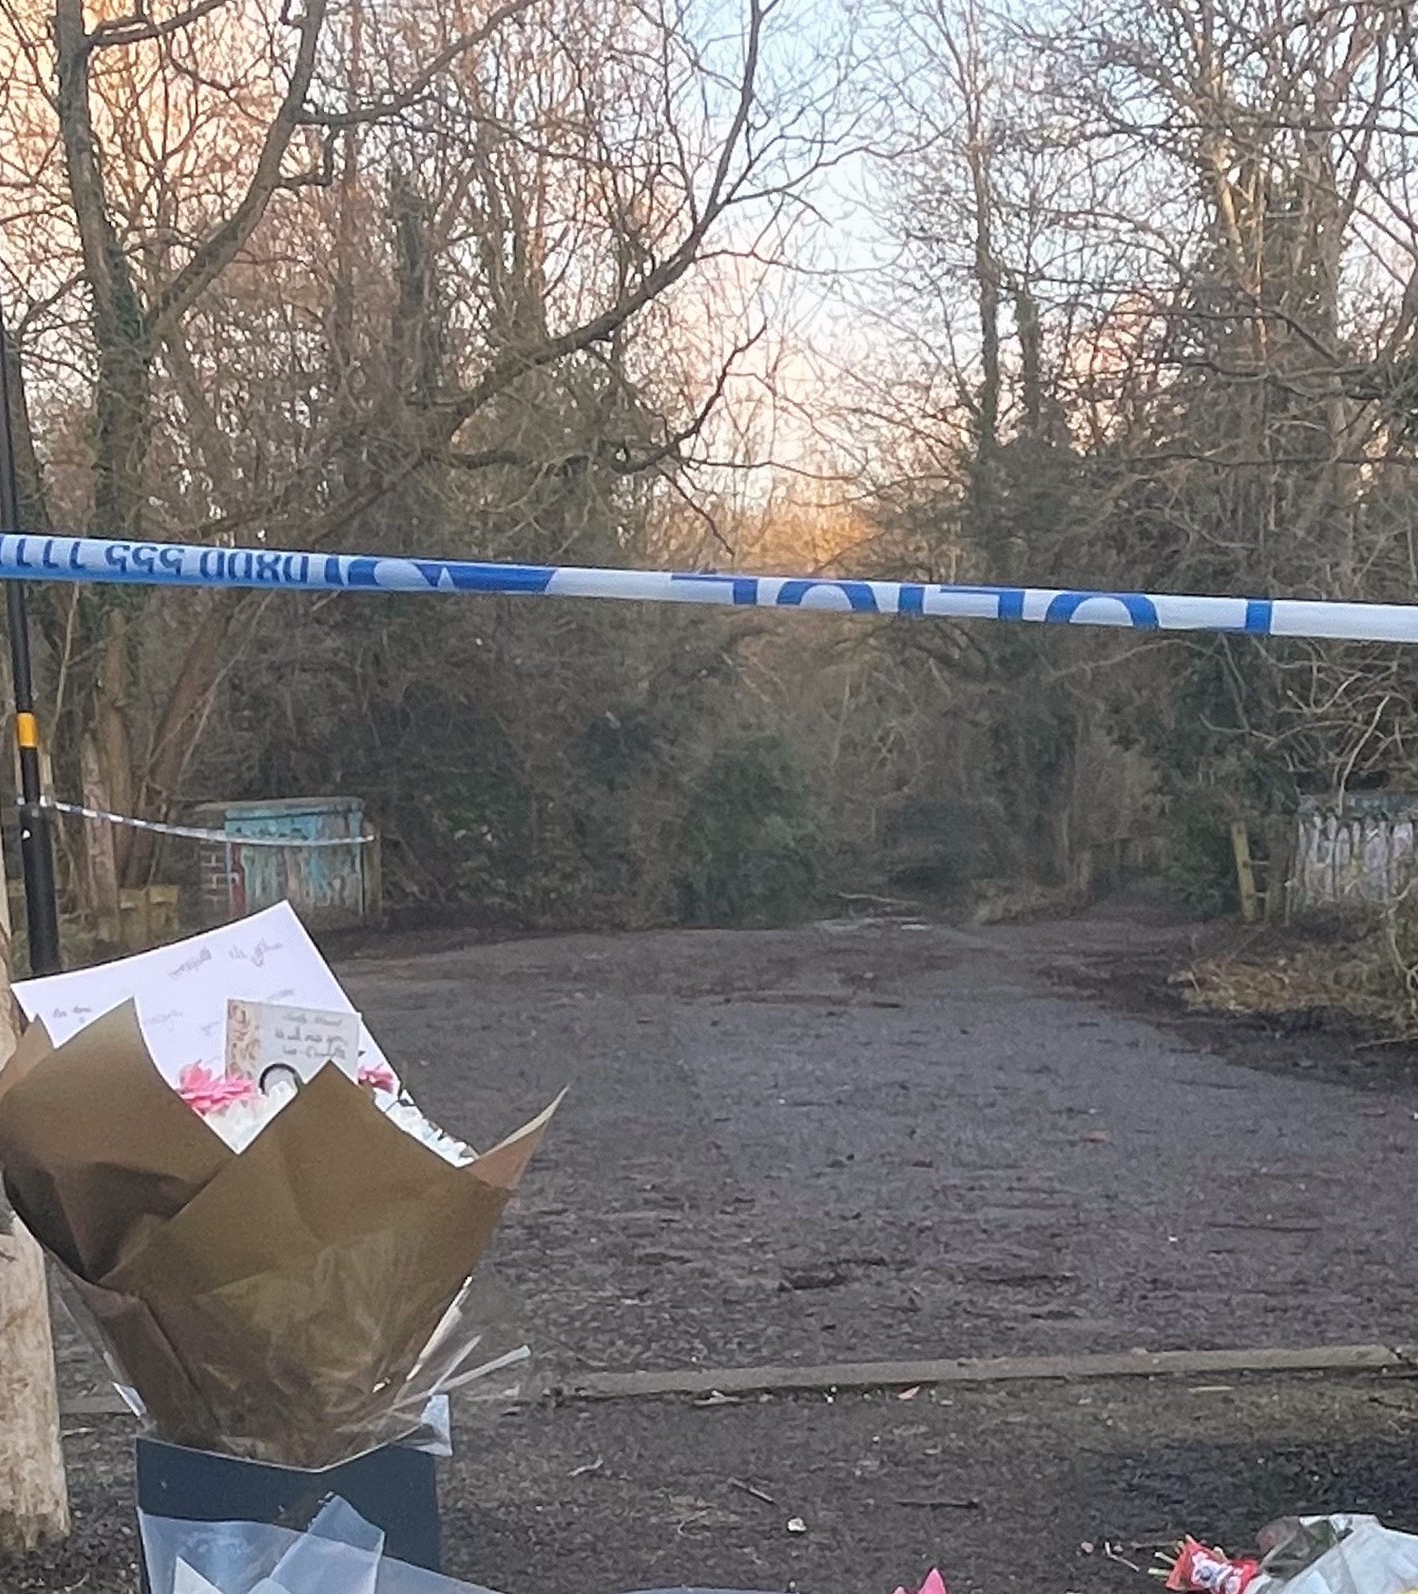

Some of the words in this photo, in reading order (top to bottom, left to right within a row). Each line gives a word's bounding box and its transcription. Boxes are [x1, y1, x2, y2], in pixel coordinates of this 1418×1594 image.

[12, 535, 86, 573] 111
[100, 540, 186, 578] 555
[197, 544, 311, 585] 0800
